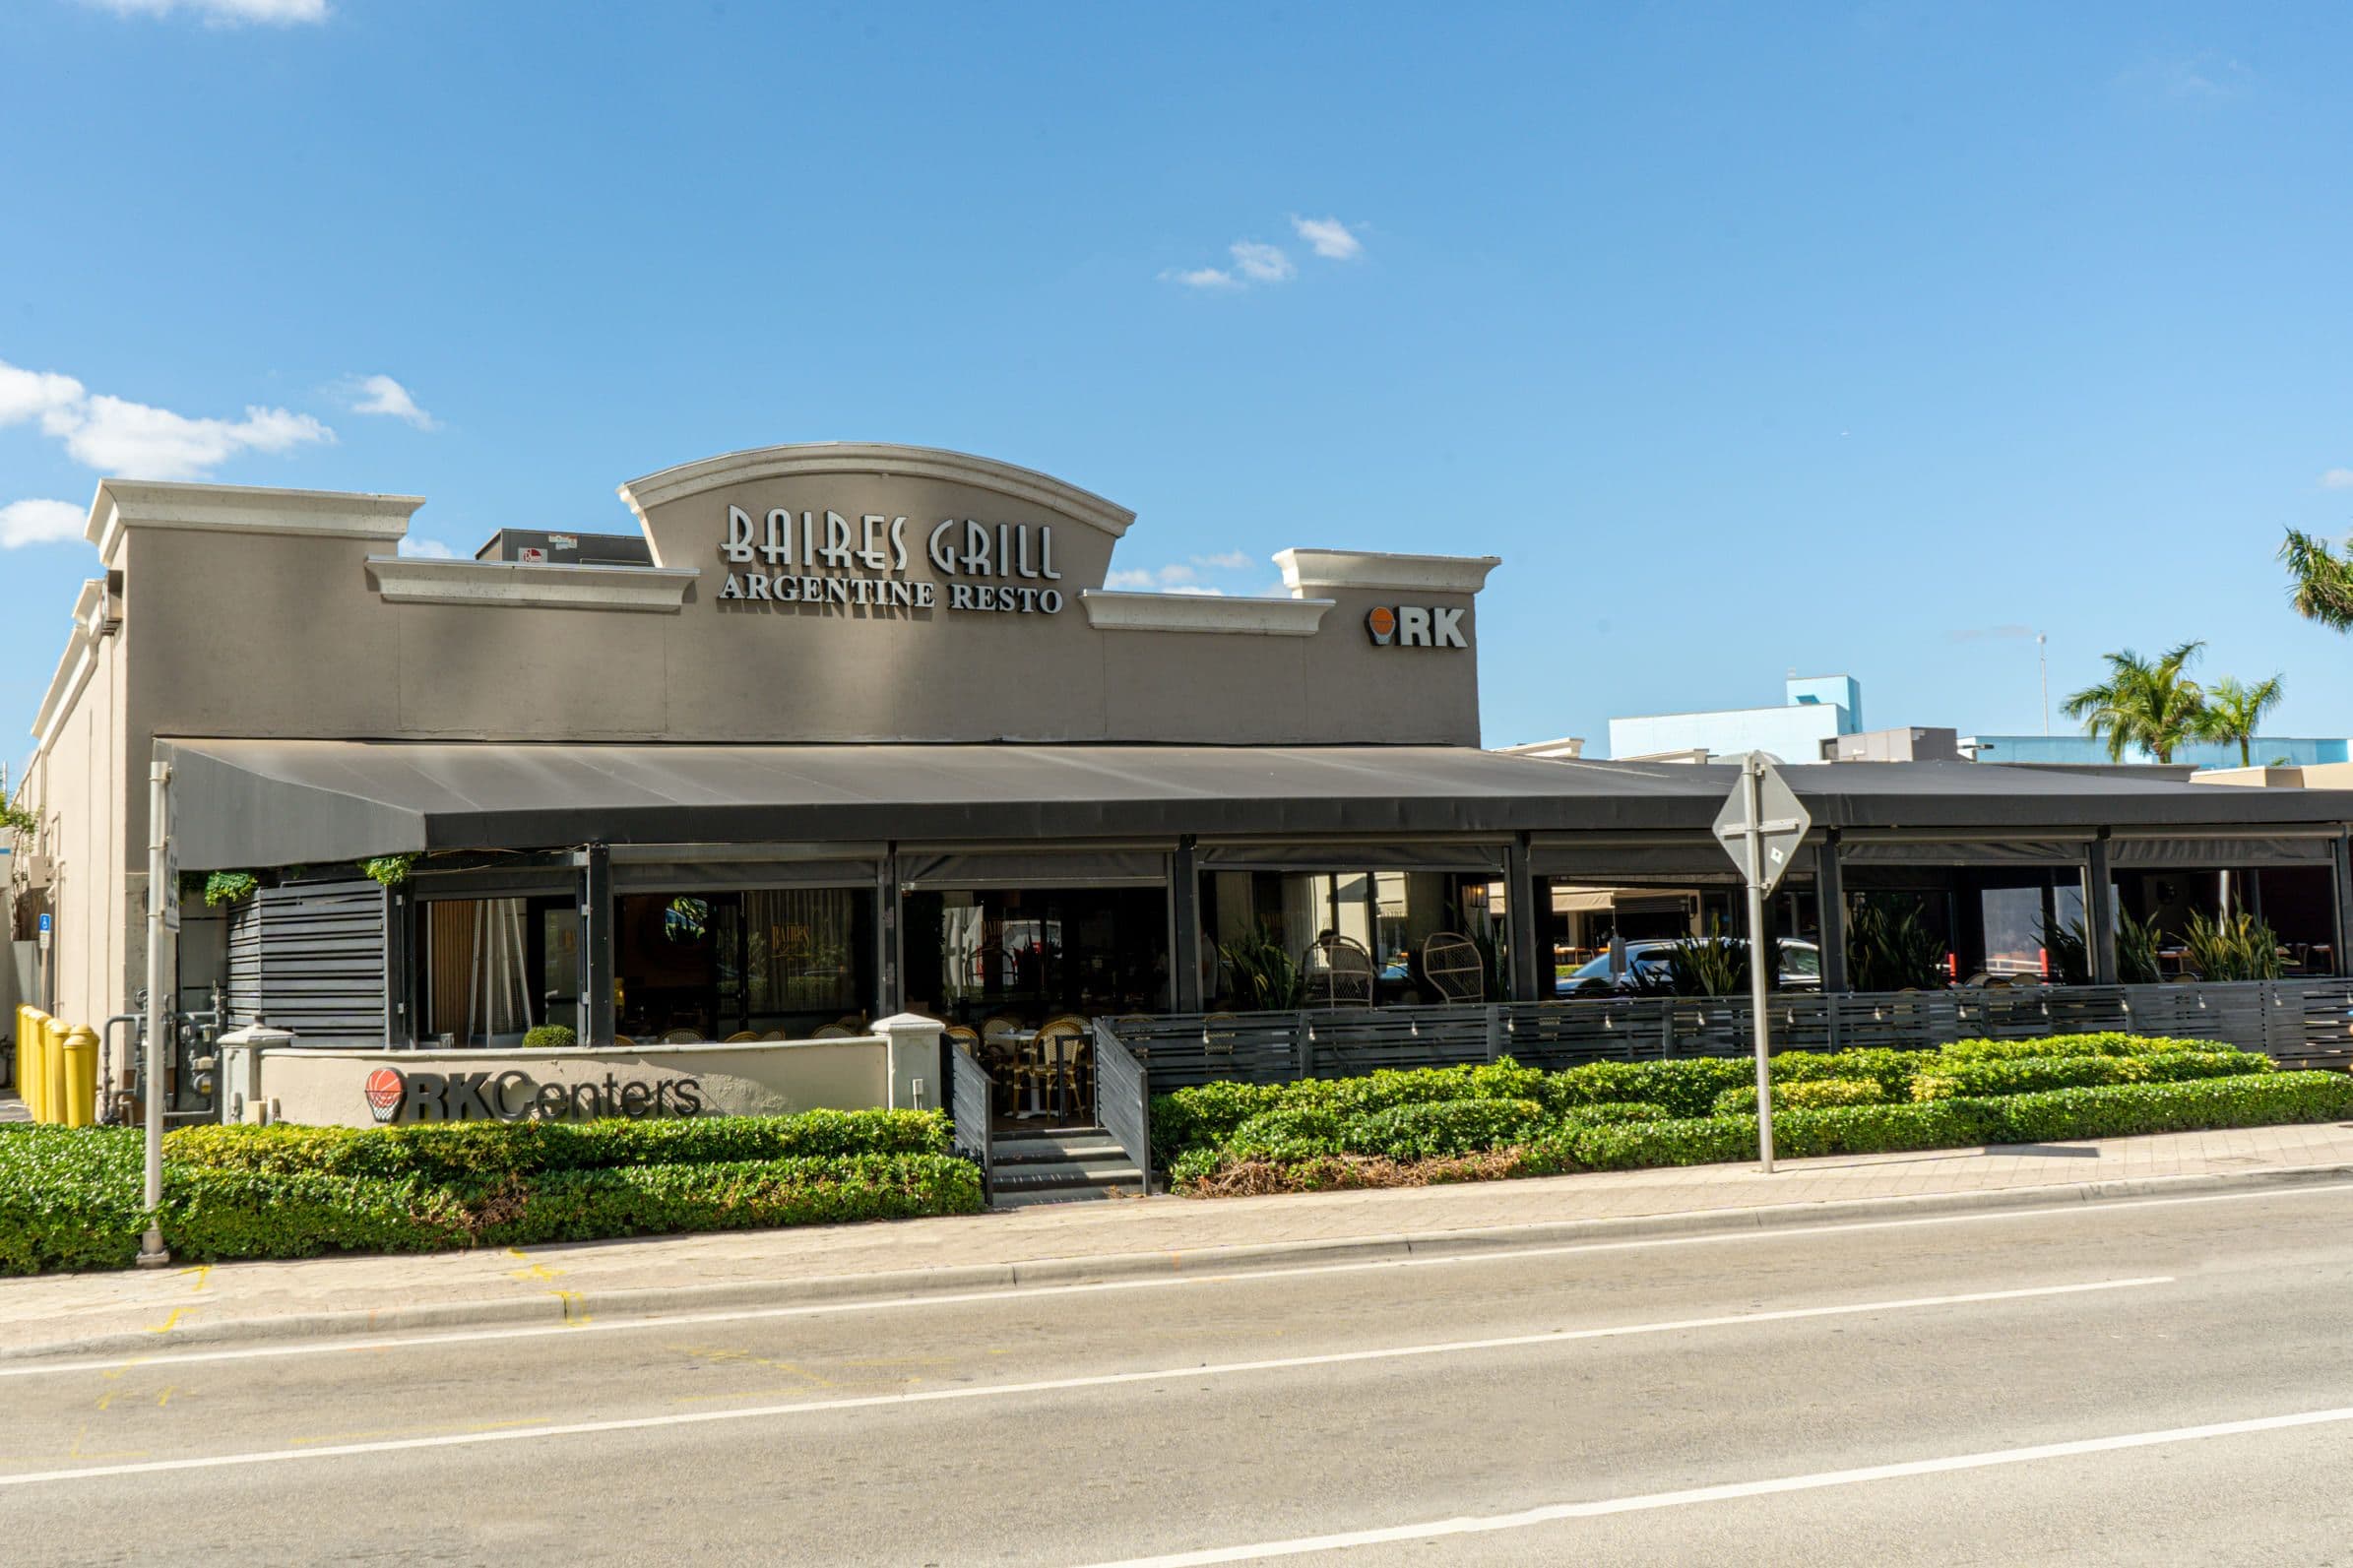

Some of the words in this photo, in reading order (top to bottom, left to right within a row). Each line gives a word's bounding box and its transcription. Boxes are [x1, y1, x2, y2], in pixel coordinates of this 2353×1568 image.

[720, 504, 908, 571] BAIRES
[928, 518, 1062, 580] GRILL
[718, 572, 935, 608] ARGENTINE
[949, 583, 1063, 614] RESTO
[1396, 605, 1468, 648] RK
